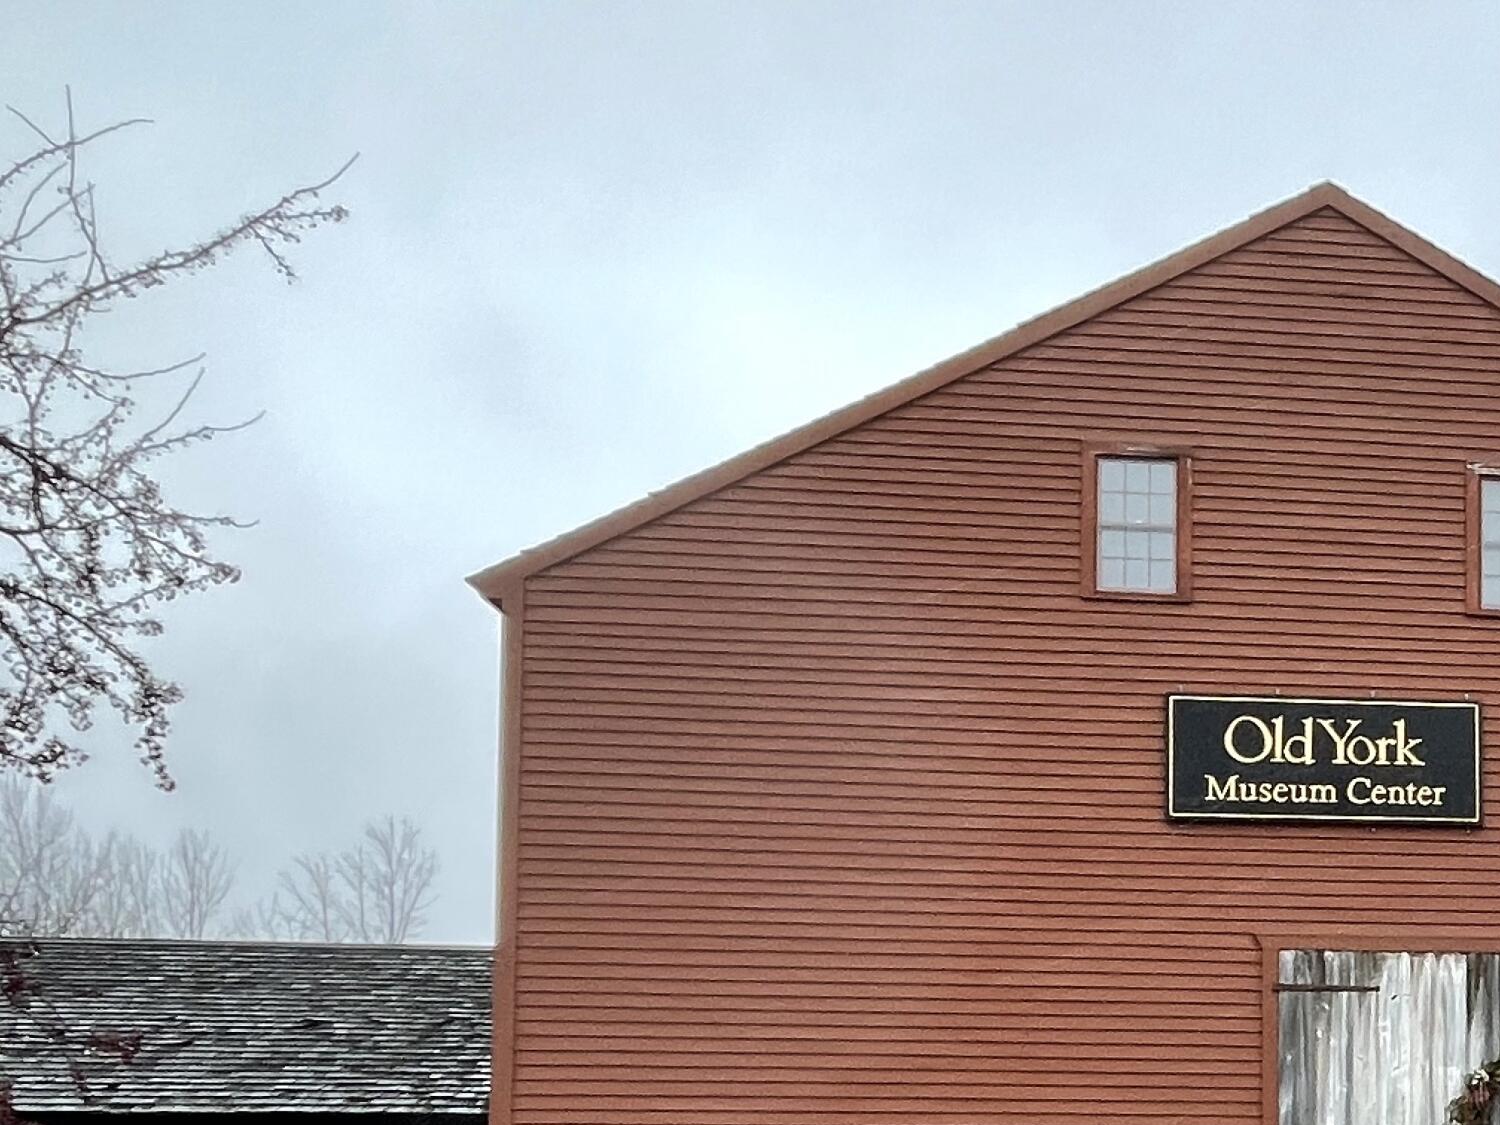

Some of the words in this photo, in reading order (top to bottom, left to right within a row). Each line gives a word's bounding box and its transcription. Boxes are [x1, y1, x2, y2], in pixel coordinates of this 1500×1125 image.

[1223, 714, 1316, 766] Old
[1316, 717, 1425, 766] York
[1203, 774, 1338, 804] Museum
[1346, 776, 1446, 806] Center
